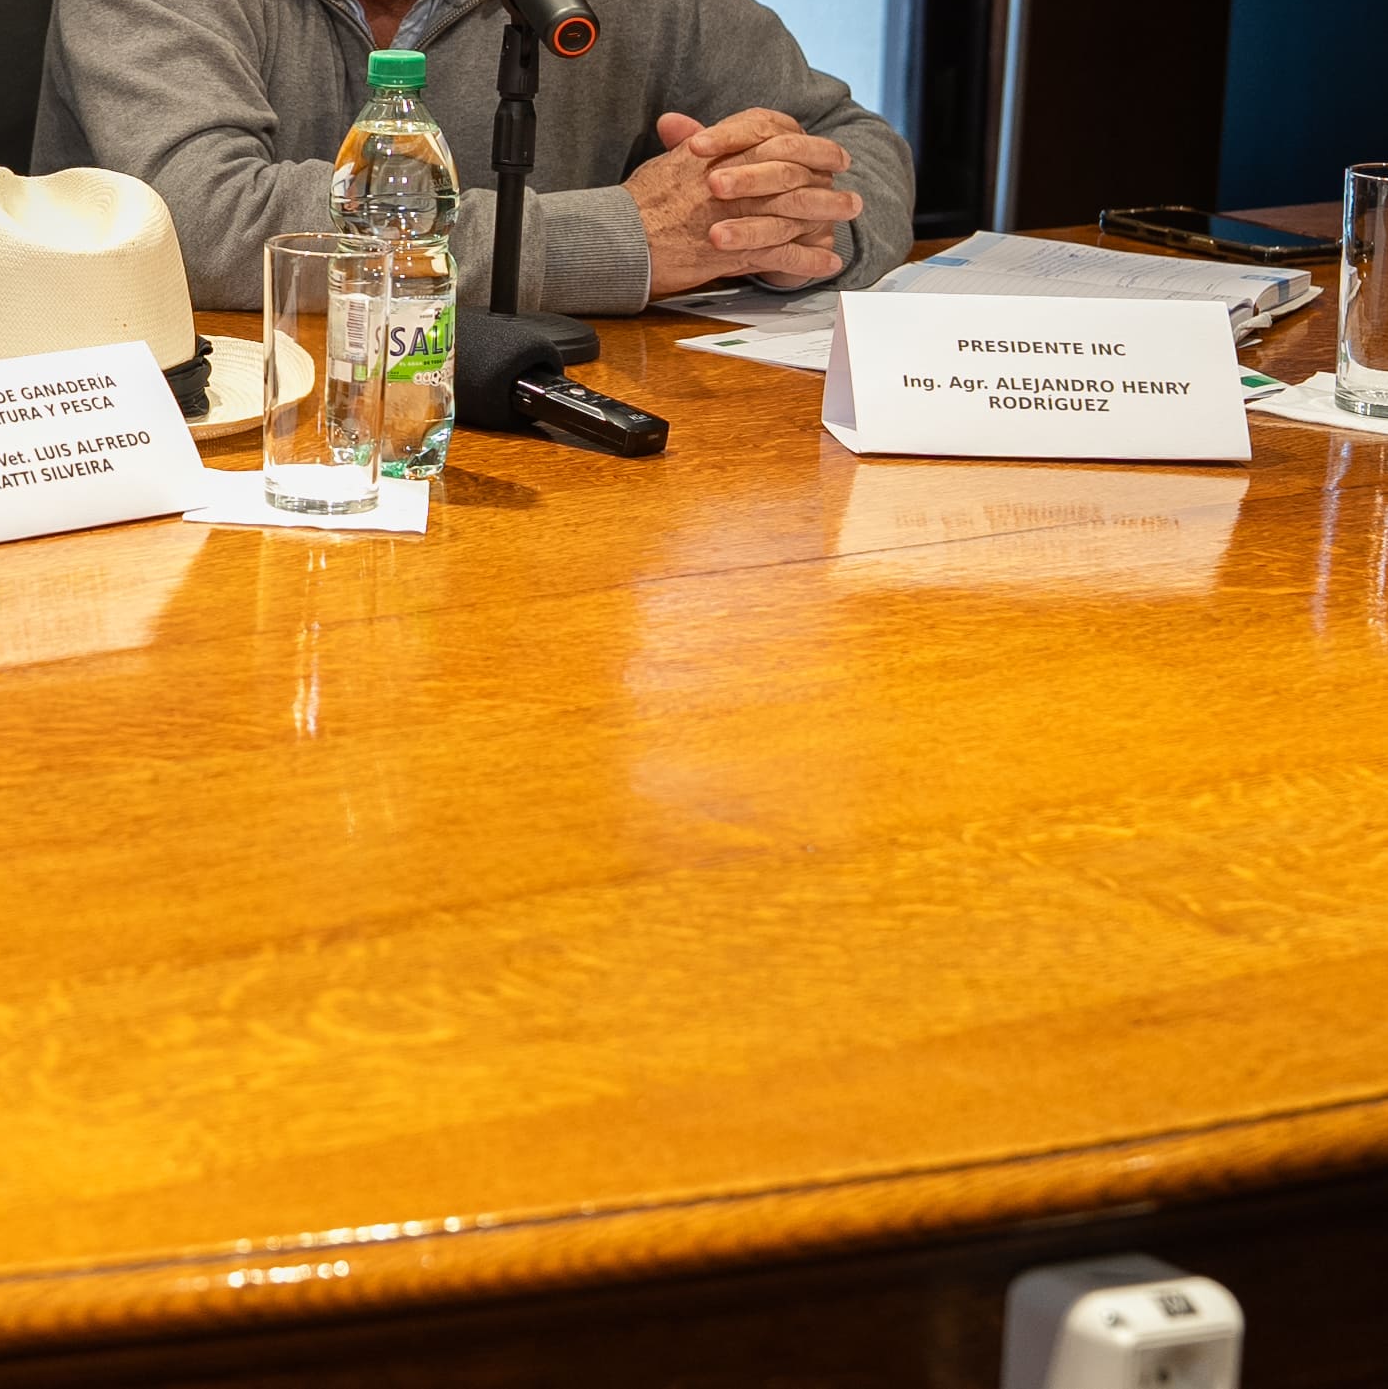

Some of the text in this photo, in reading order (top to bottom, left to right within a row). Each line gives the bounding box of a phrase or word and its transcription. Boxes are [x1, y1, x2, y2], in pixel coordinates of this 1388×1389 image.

[389, 325, 454, 357] SALU
[957, 339, 1126, 357] PRESIDENTE INC
[902, 374, 1191, 395] Ing. Agr. ALEJANDRO HENRY
[43, 403, 55, 417] Y
[59, 395, 115, 415] PESCA
[988, 395, 1110, 412] RODRÍGUEZ
[33, 442, 72, 462] LUIS
[77, 430, 151, 455] ALFREDO
[40, 458, 115, 483] SILVEIRA
